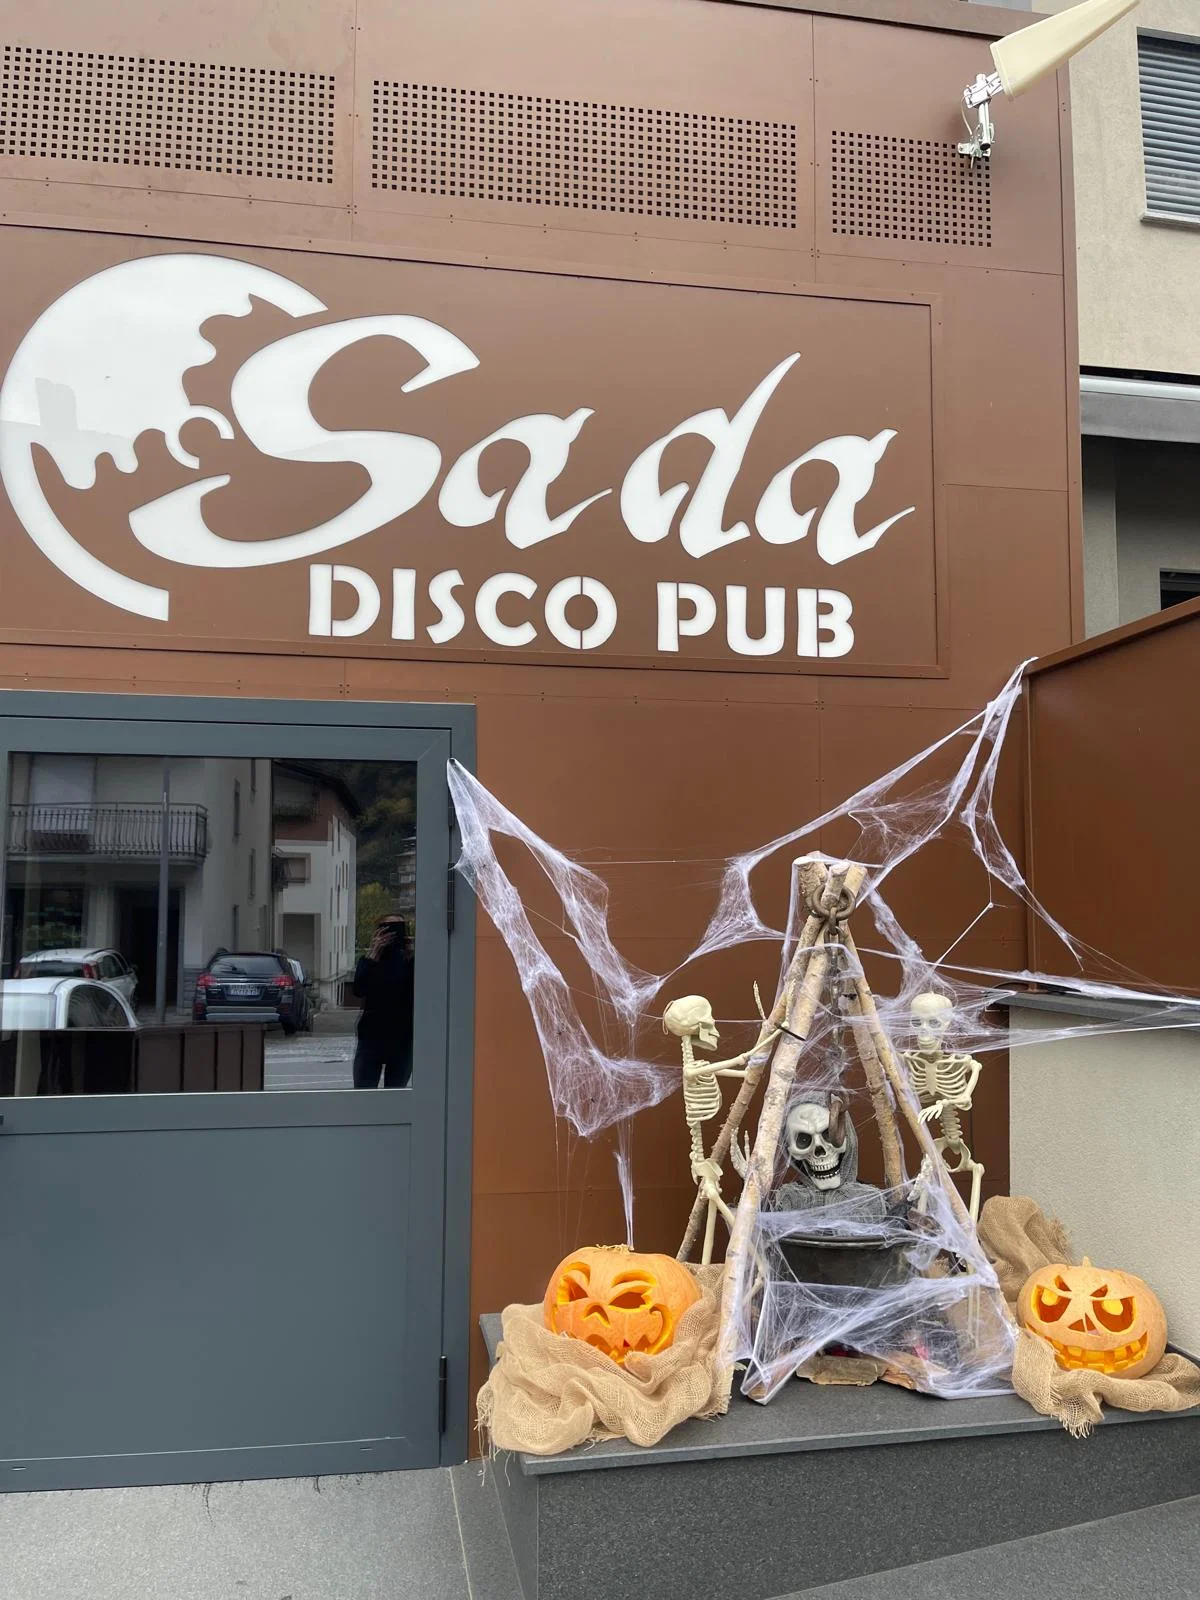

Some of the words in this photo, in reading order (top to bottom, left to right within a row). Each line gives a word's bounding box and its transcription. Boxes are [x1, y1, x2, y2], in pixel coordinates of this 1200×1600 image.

[128, 314, 916, 568] Sada
[308, 564, 618, 650] DISCO
[656, 582, 855, 658] PUB
